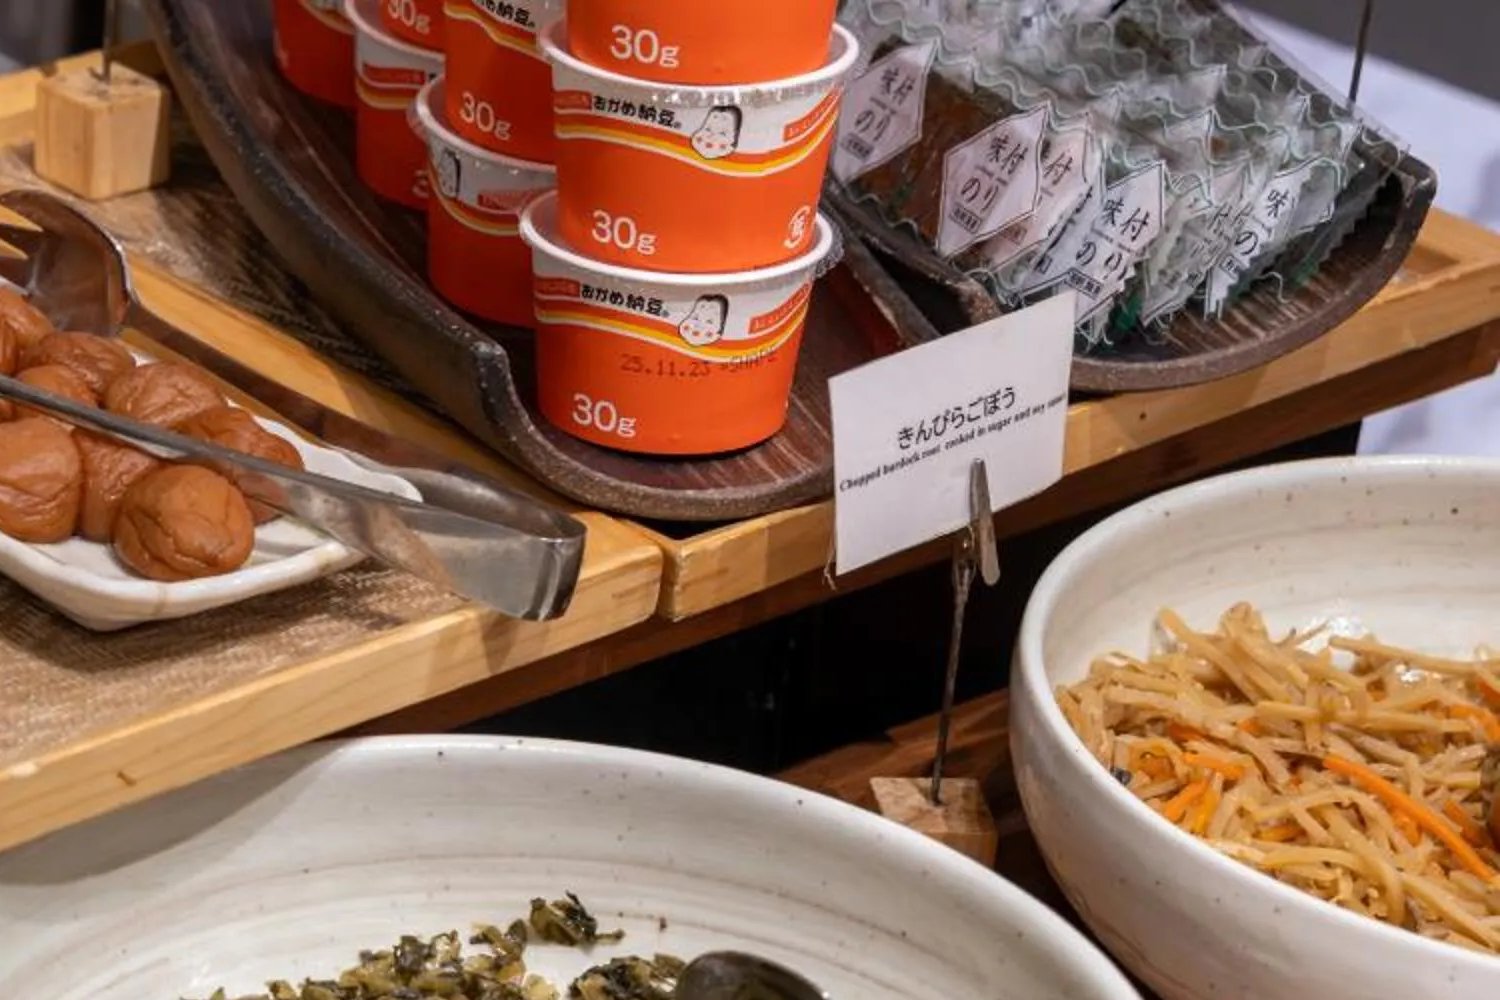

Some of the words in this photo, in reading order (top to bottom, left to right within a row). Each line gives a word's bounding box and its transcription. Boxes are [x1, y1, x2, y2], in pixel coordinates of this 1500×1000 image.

[610, 24, 680, 68] 30g
[459, 91, 512, 141] 30g
[960, 176, 999, 212] のり
[591, 208, 657, 256] 30g
[581, 283, 665, 318] おかめ納豆
[573, 393, 637, 438] 30g
